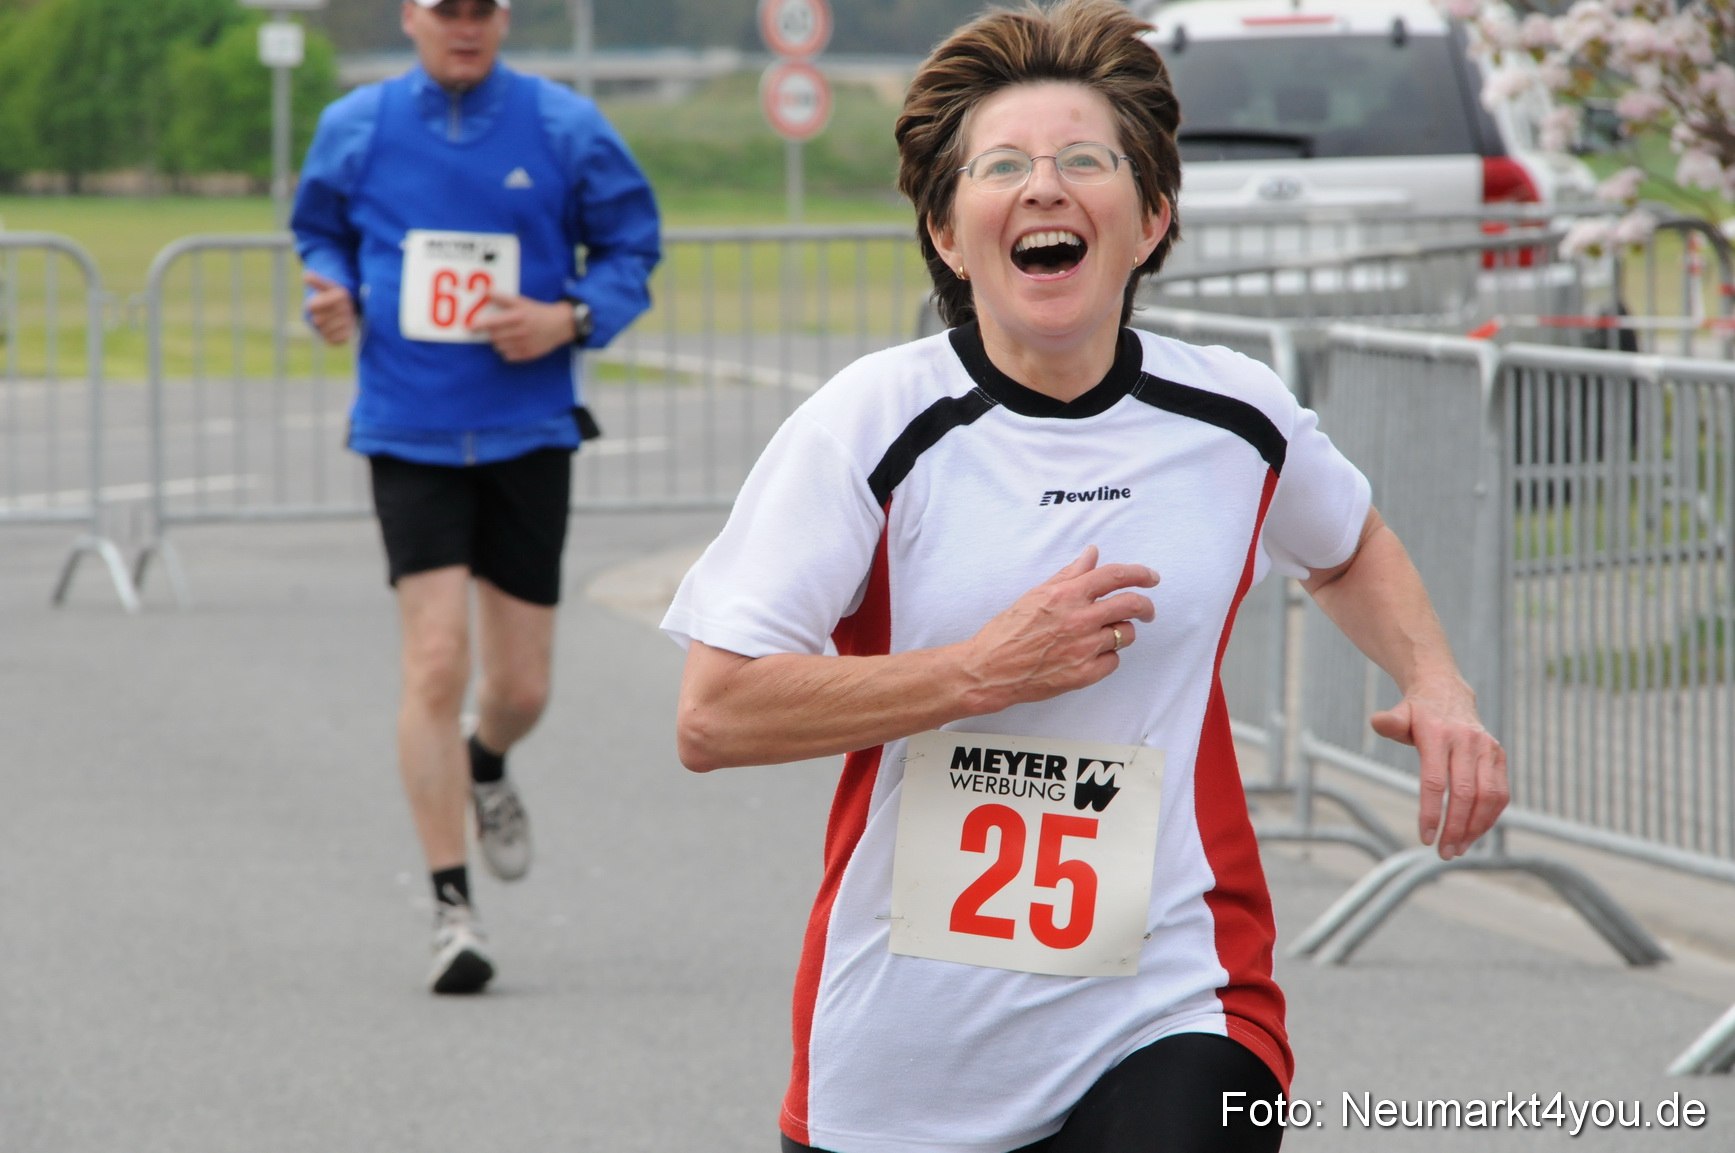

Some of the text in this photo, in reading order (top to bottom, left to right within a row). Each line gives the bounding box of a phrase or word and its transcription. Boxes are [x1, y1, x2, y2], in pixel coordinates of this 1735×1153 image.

[431, 270, 492, 328] 62
[949, 771, 1067, 802] WERBUNG
[950, 746, 1068, 781] MEYER
[948, 803, 1100, 950] 25
